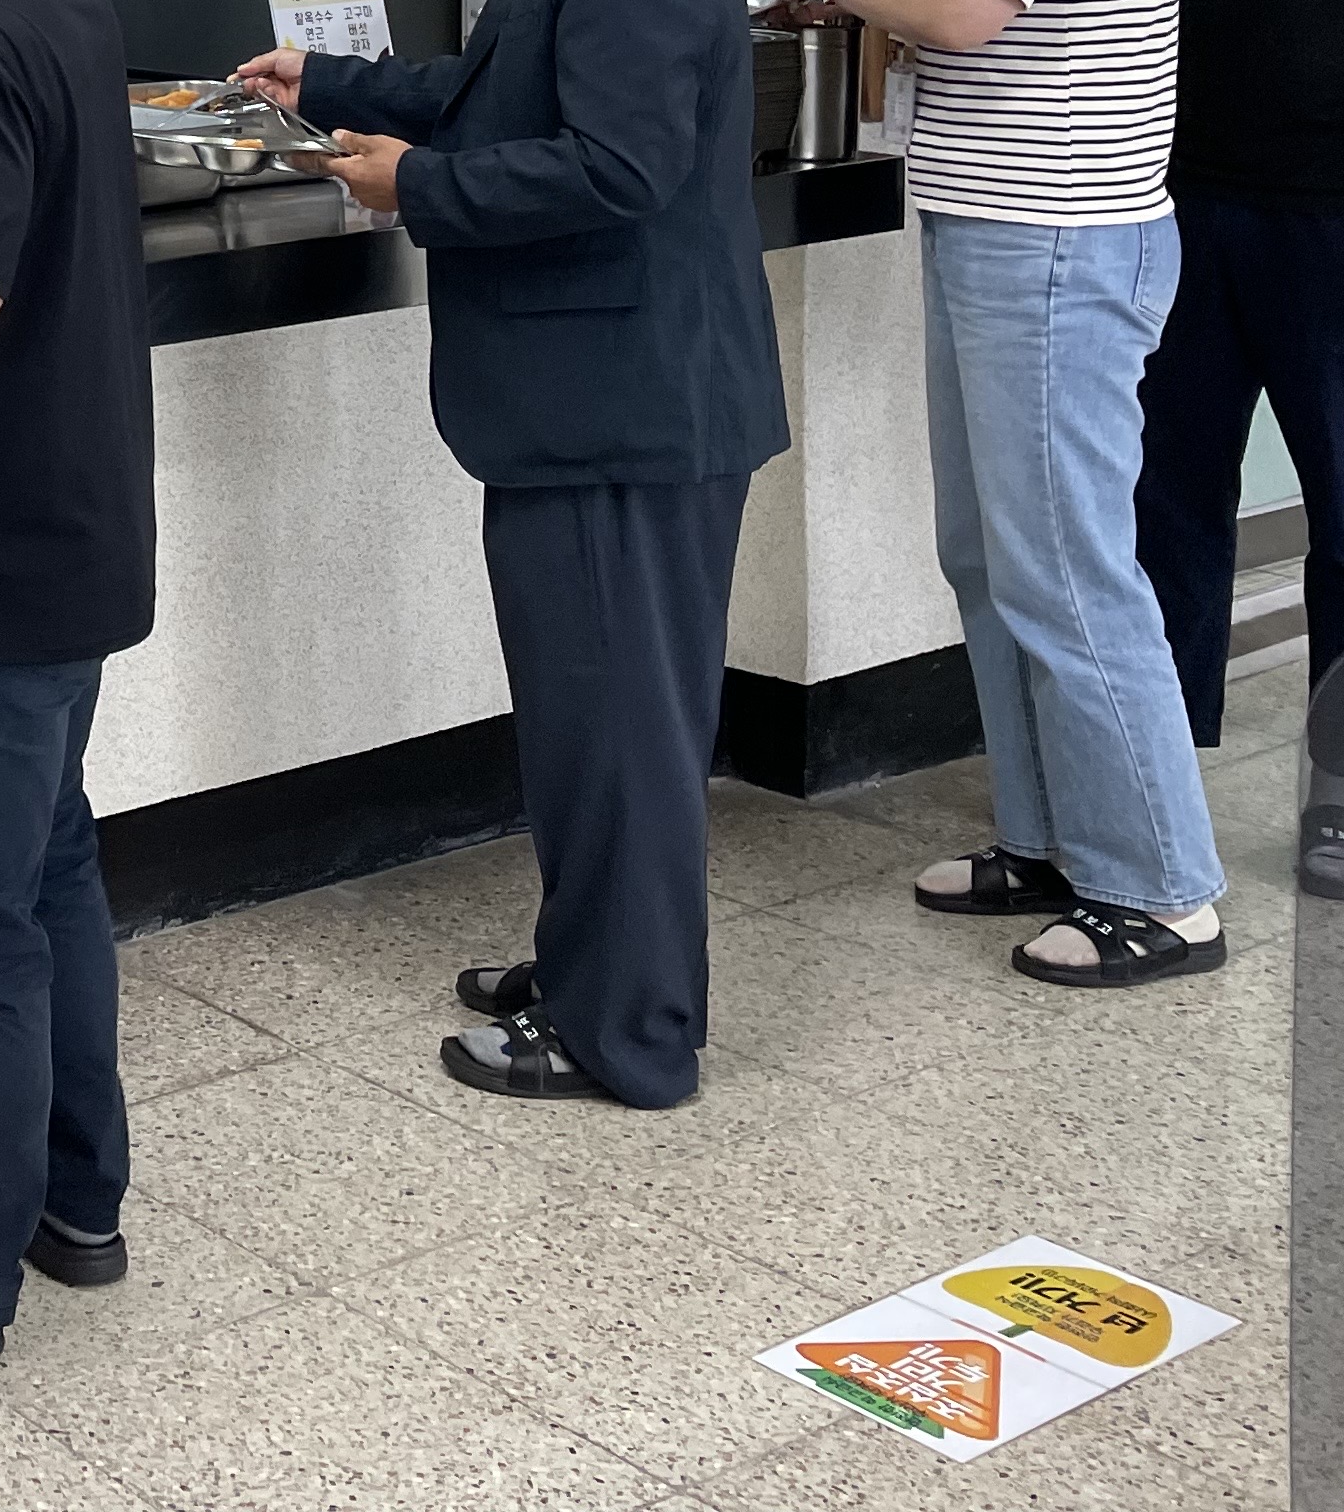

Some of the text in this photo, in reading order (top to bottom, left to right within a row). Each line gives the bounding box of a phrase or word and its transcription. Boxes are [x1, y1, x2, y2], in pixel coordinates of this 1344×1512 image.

[343, 5, 373, 21] 고구마
[347, 23, 368, 36] 버섯
[351, 39, 371, 53] 감자
[1005, 1272, 1102, 1314] 거기!
[887, 1355, 965, 1392] 거리
[906, 1341, 995, 1383] 두기!
[832, 1352, 975, 1420] 조심조심
